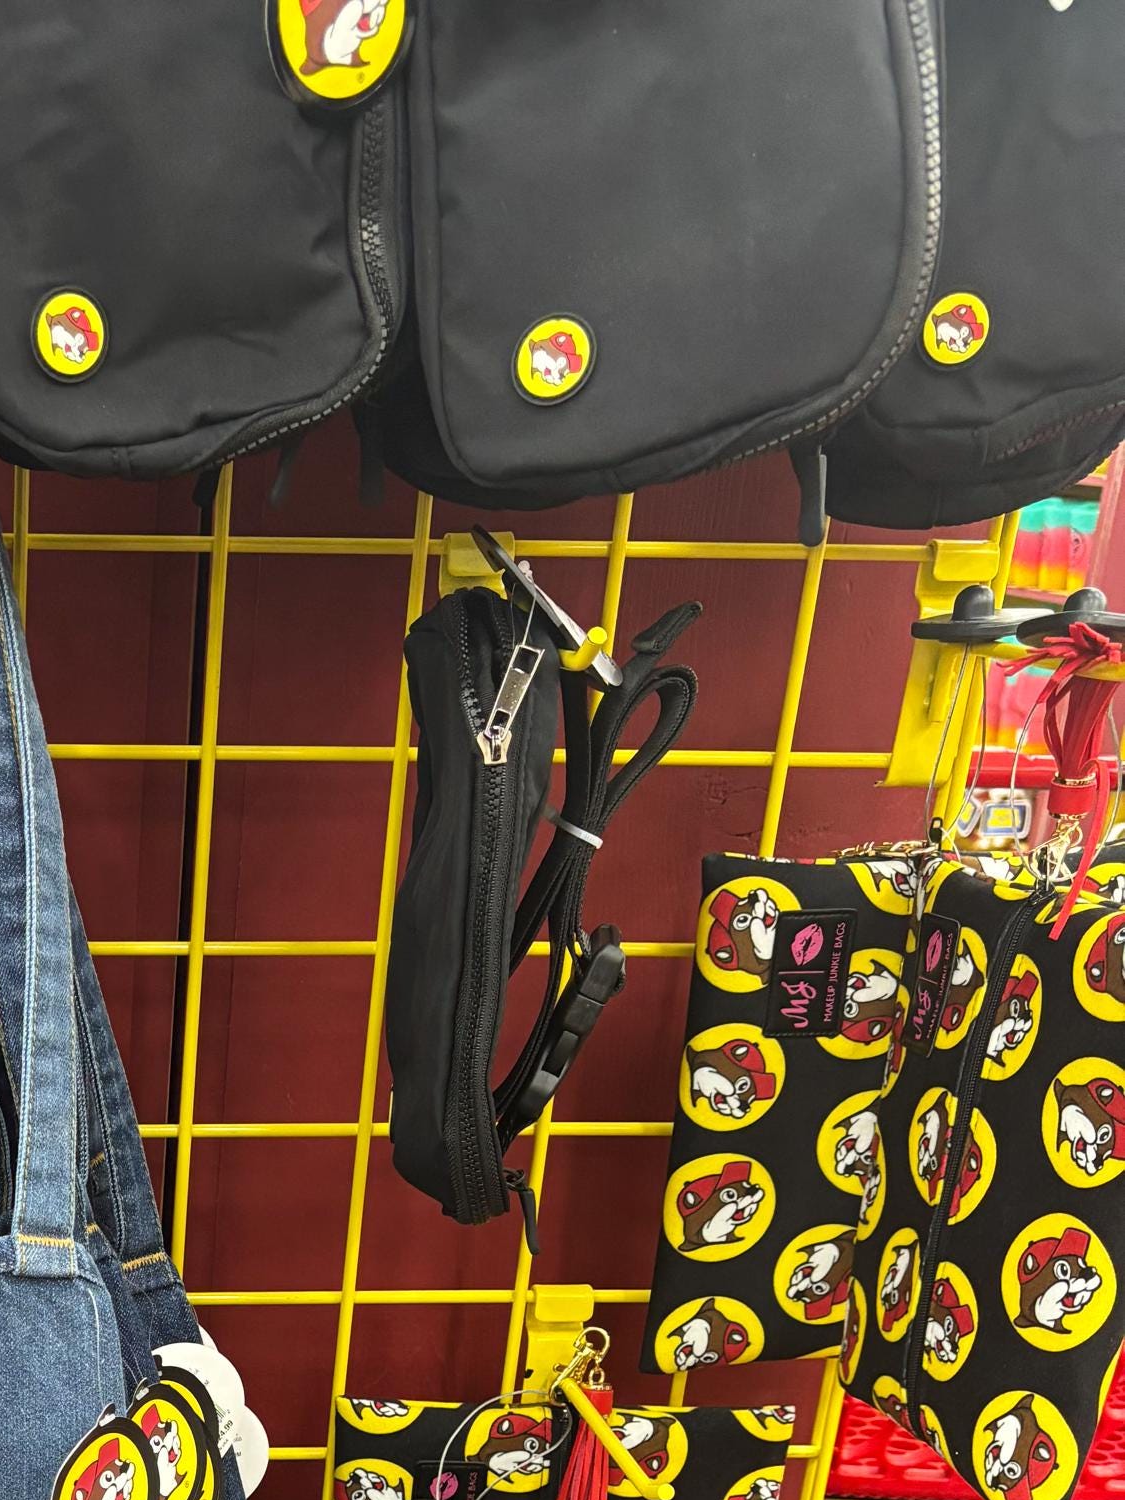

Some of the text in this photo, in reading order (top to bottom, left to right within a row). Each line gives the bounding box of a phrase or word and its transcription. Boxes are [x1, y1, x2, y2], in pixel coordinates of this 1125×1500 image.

[944, 932, 954, 961] BAGS
[824, 922, 846, 1022] MAKEUP JUNKIE BAGS
[468, 1472, 478, 1491] BAGS
